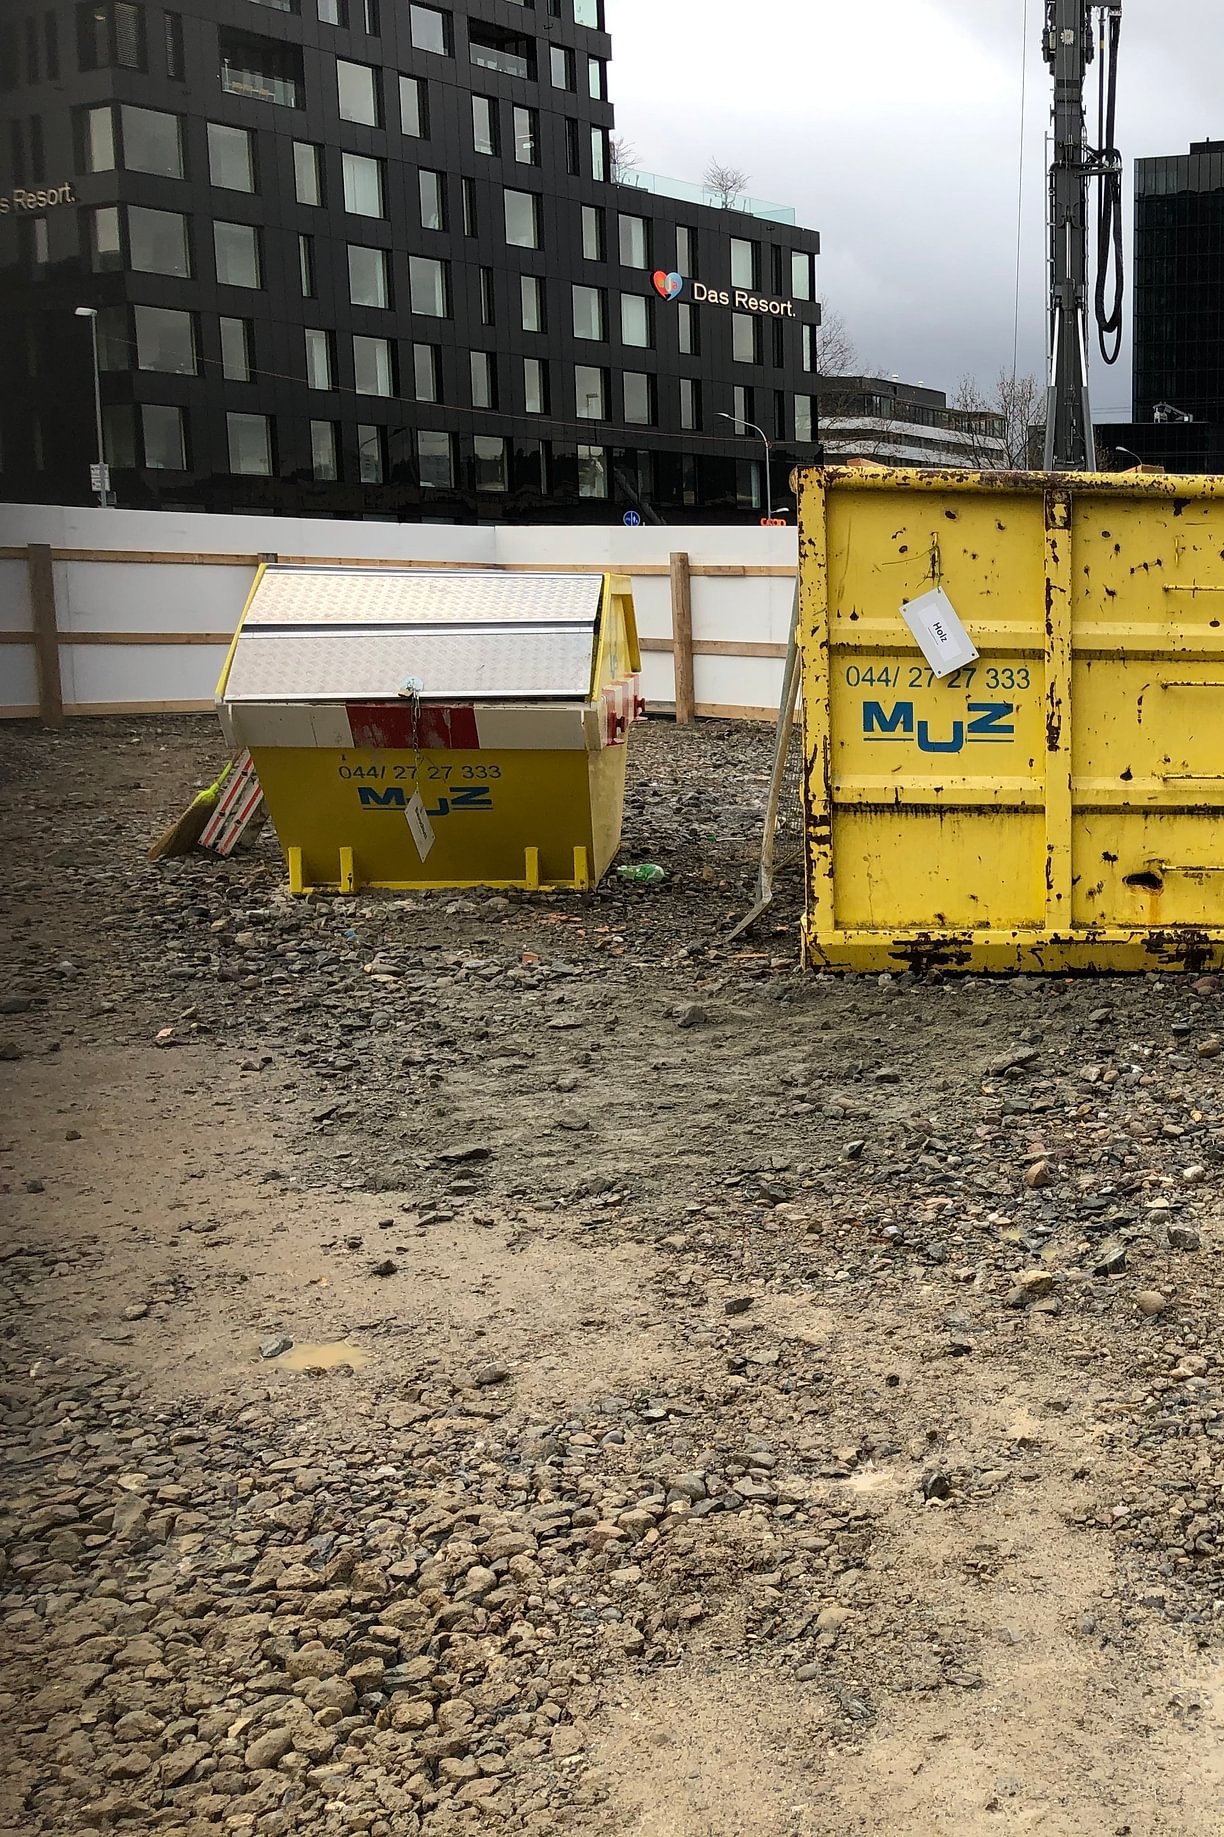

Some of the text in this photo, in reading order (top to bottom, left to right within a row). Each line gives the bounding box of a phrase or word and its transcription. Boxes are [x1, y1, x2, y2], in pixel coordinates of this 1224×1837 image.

[13, 182, 75, 209] Resort.
[694, 282, 796, 317] Das Resort.
[932, 621, 948, 644] Holz
[845, 665, 900, 688] 044/
[946, 667, 977, 689] 27
[985, 668, 1031, 690] 333
[862, 701, 1015, 753] MUZ
[338, 765, 502, 780] 044/ 27 27 333
